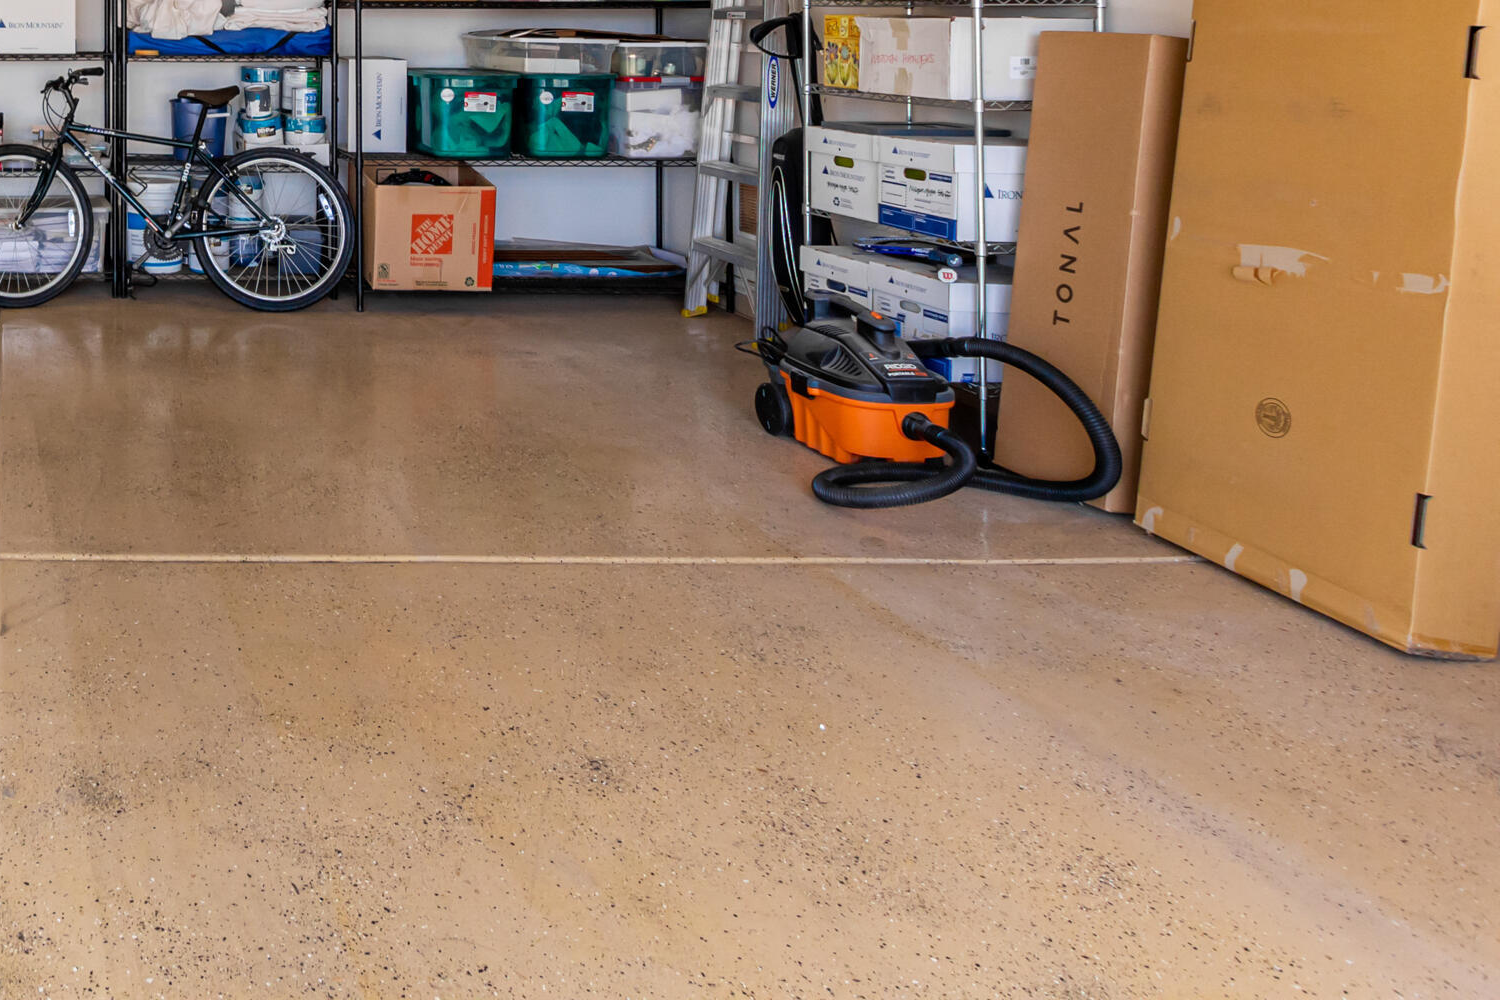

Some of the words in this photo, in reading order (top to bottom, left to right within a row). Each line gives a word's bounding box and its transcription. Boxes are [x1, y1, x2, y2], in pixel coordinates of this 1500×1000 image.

[181, 162, 192, 182] 800
[997, 189, 1023, 200] IRON
[411, 213, 453, 254] HOME
[415, 217, 433, 234] THE
[427, 229, 453, 255] DEPOT
[1052, 201, 1084, 326] TONAL
